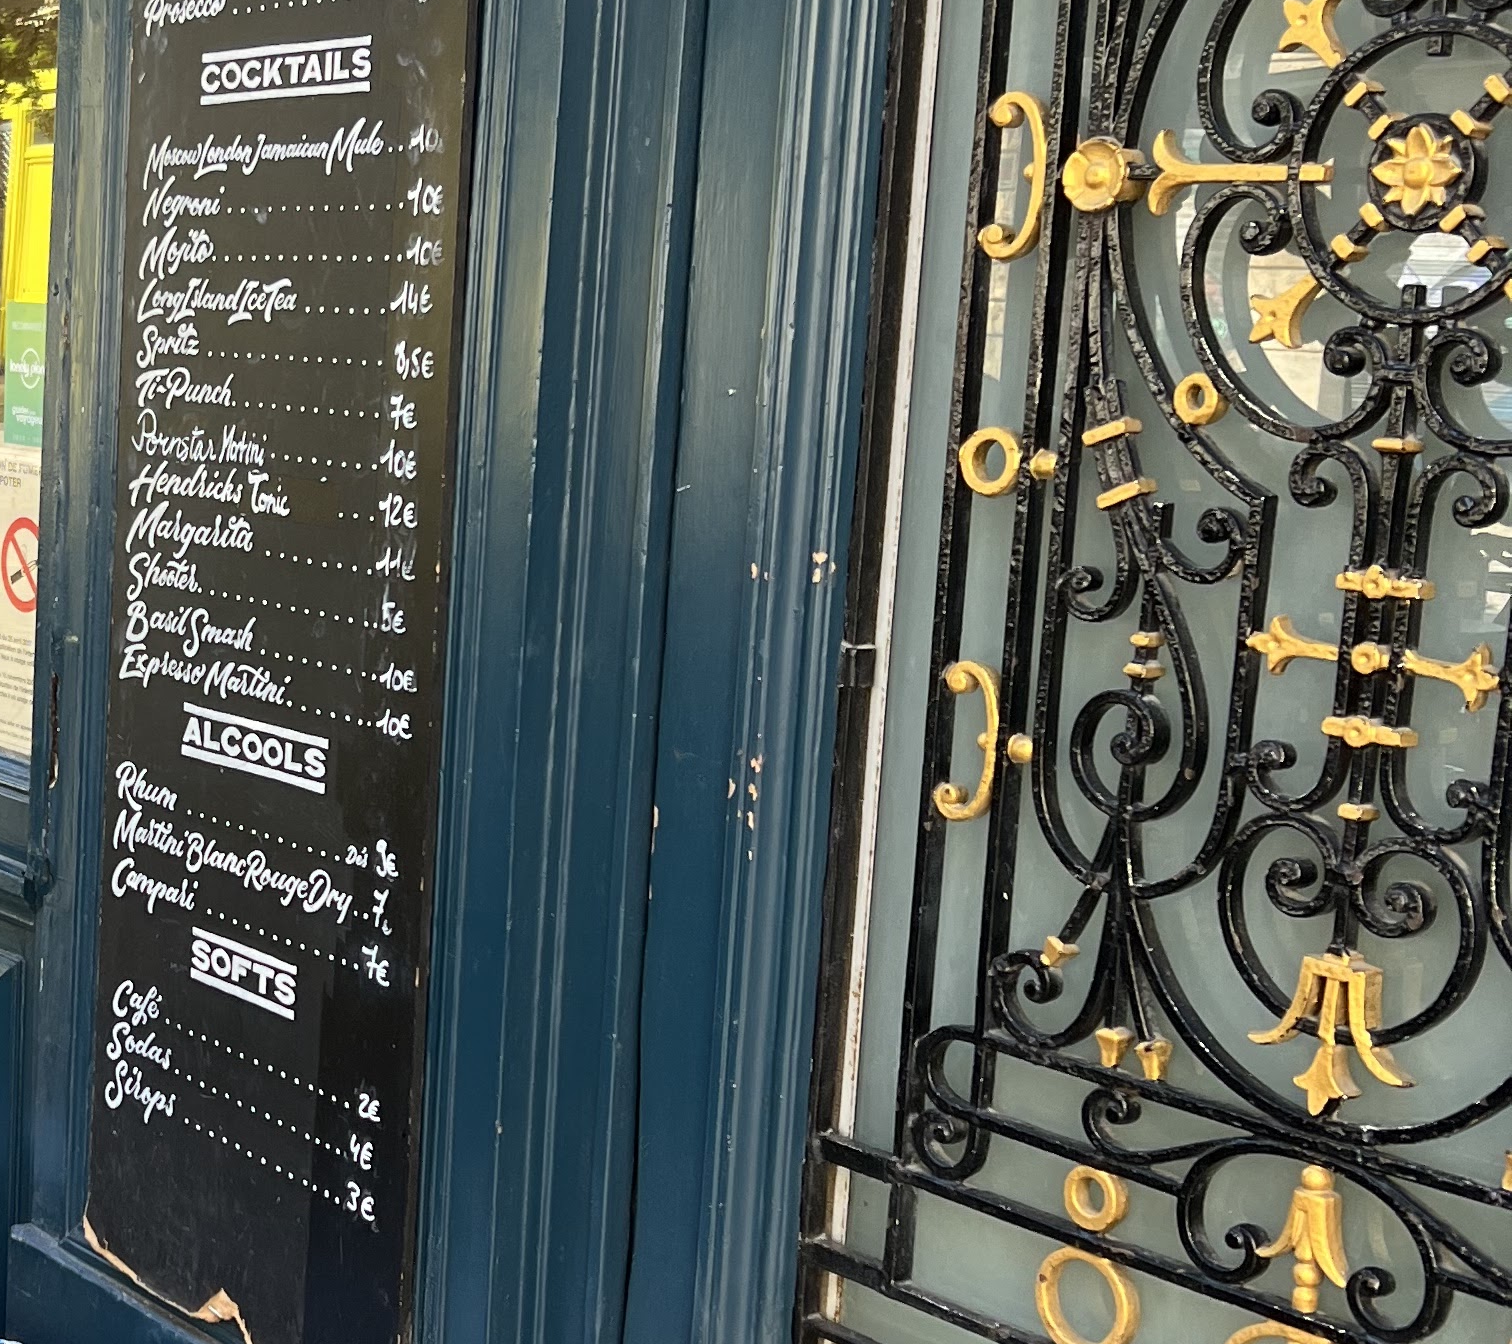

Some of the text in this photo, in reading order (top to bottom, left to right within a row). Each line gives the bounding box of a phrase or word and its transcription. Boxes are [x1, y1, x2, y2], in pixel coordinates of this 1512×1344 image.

[201, 47, 372, 93] COCKTAILS
[142, 176, 226, 227] Negroni
[139, 226, 214, 280] Mojito
[29, 360, 45, 376] plan
[137, 323, 199, 369] Spritz
[136, 367, 418, 431] Ti-Punch 7€
[132, 408, 217, 462] Pornstar
[218, 425, 267, 466] Martini
[8, 462, 17, 473] DE
[129, 461, 418, 529] Hendricks Tonic 12€
[125, 500, 254, 559] Margarita
[127, 552, 197, 601] Shooter
[125, 600, 418, 693] Basil Smash 10€
[203, 660, 292, 706] Martini
[376, 709, 412, 739] 10€
[182, 716, 327, 779] ALCOOLS
[115, 760, 178, 811] Rhum
[111, 858, 199, 914] Campari
[191, 940, 296, 1005] SOFTS
[112, 979, 381, 1122] Café 2€
[106, 1021, 374, 1170] Sodas 4€
[104, 1060, 376, 1221] Sirops 3€
